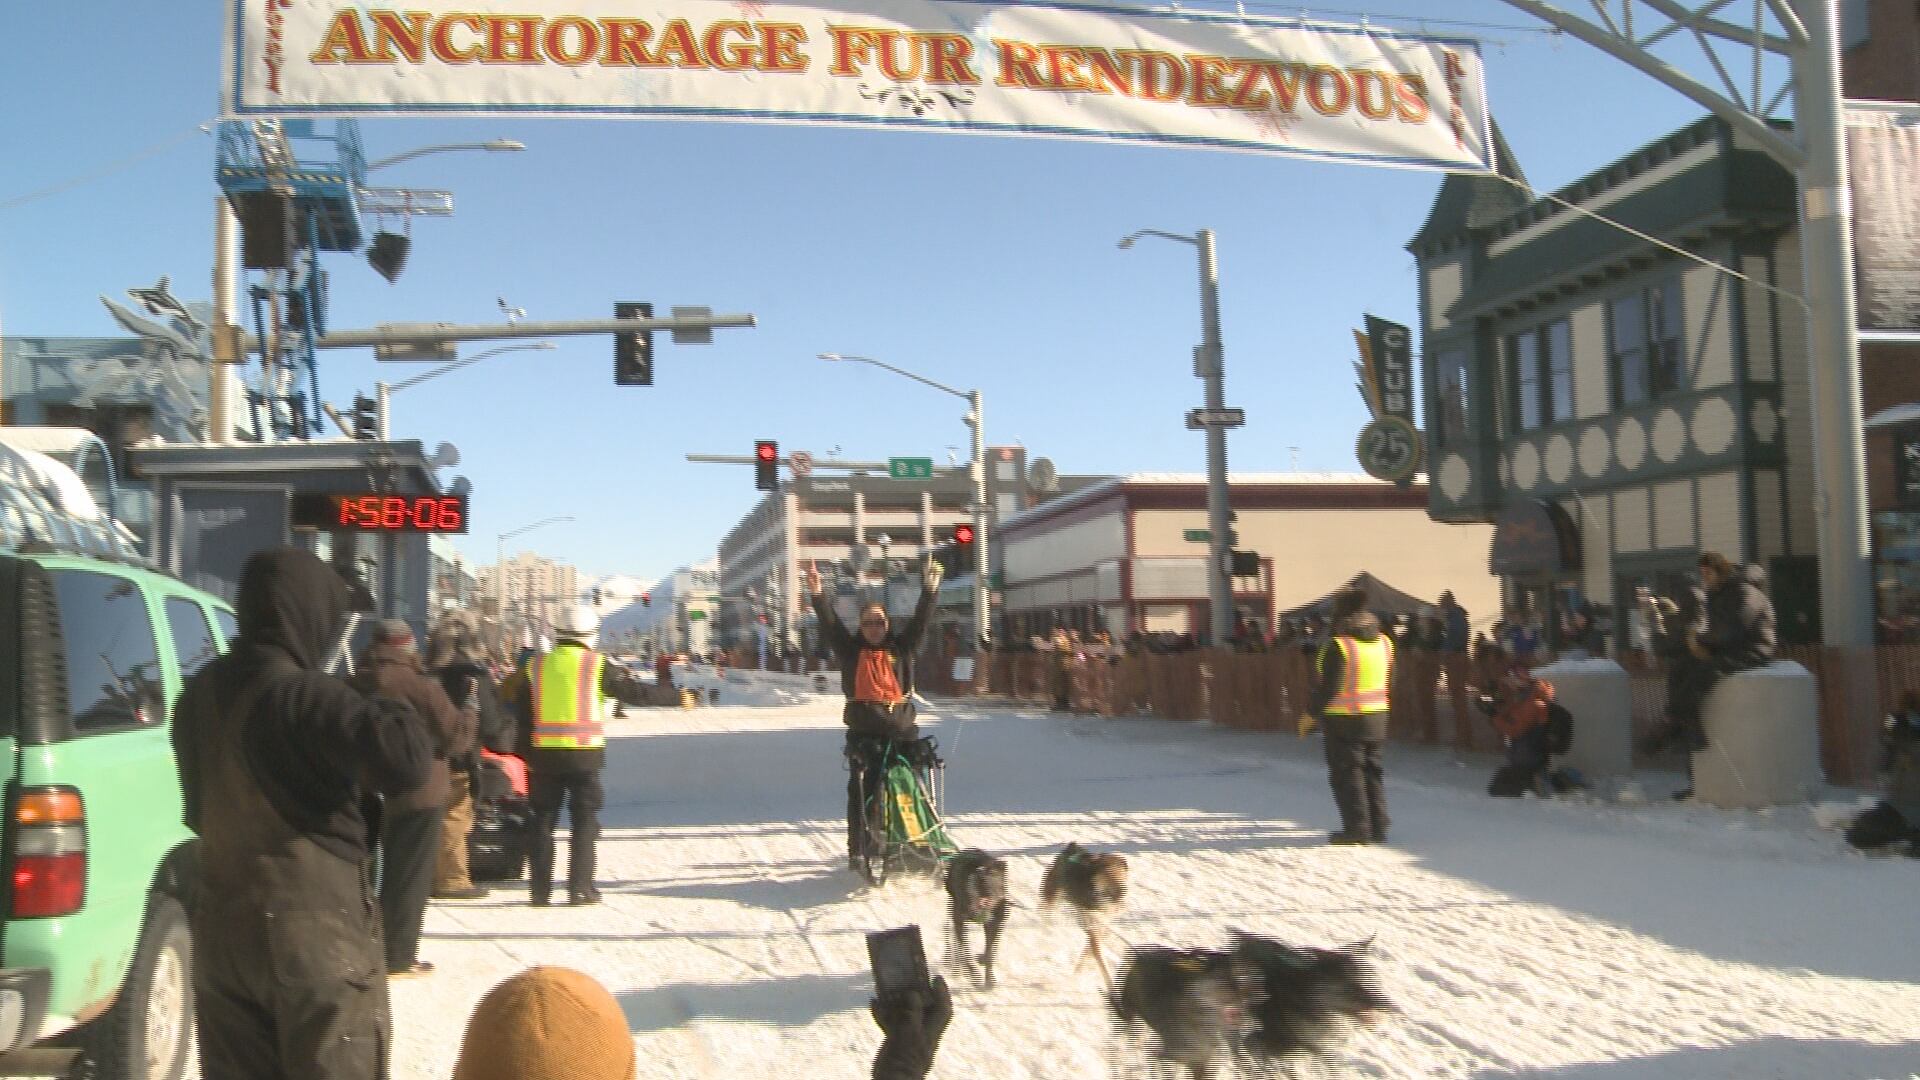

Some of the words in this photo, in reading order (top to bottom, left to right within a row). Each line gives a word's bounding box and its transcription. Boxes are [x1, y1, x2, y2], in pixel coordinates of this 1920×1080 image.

[311, 8, 810, 73] ANCHORAGE
[827, 26, 982, 85] FUR
[994, 38, 1430, 124] RENDEZVOUS
[1384, 328, 1406, 413] CLUB
[1370, 430, 1410, 472] 25
